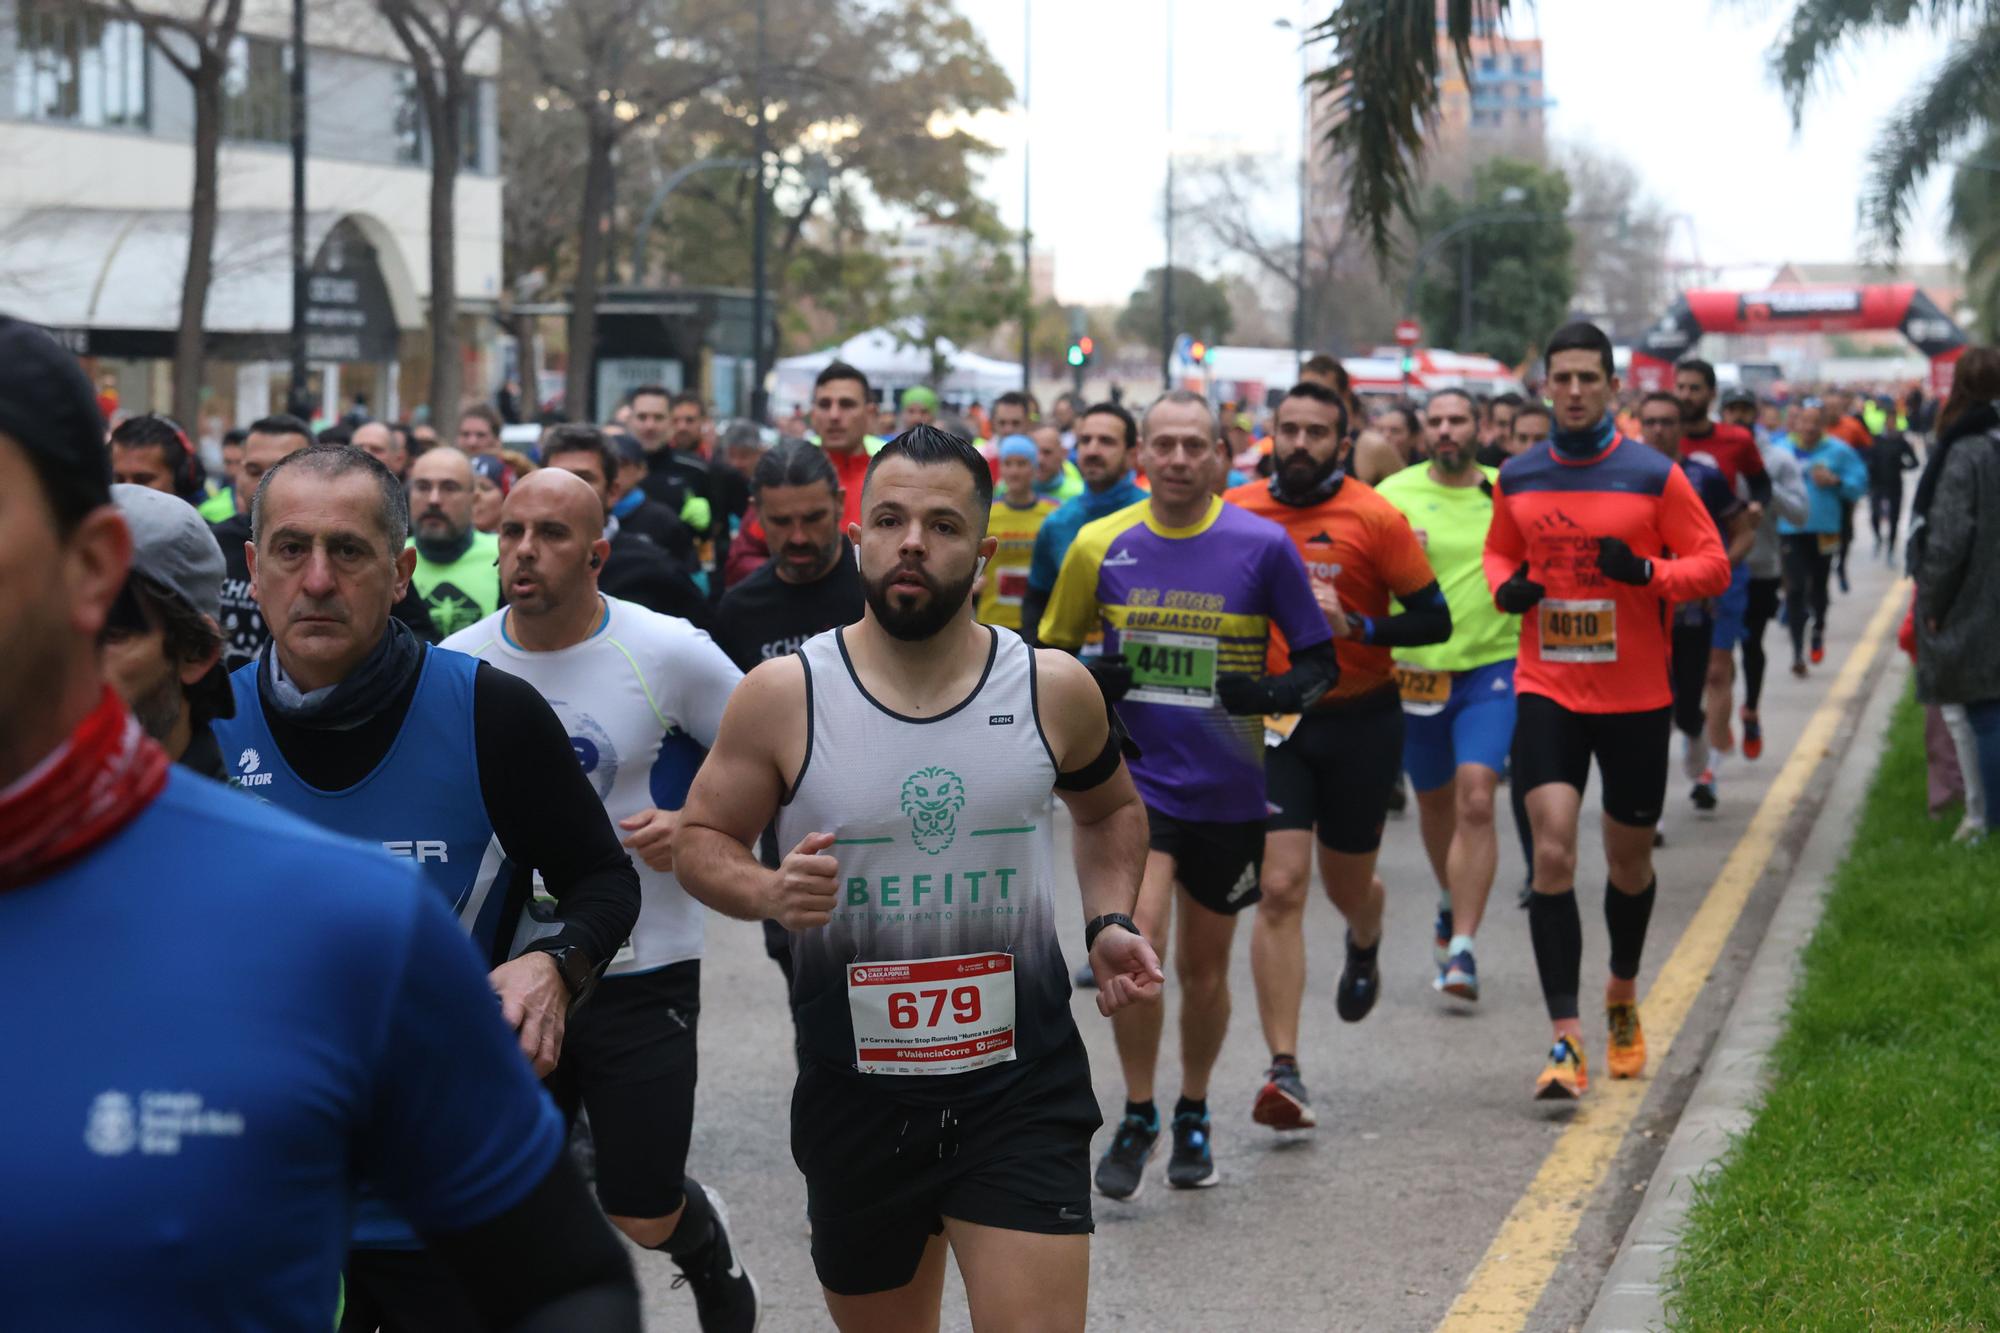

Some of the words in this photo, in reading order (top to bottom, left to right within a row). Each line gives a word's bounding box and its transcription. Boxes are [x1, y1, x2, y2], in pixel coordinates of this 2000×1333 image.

[1126, 611, 1223, 631] BURJASSOT
[1549, 612, 1598, 637] 4010
[1137, 645, 1195, 677] 4411
[232, 773, 273, 787] ATOR
[847, 868, 1017, 906] BEFITT
[887, 985, 982, 1030] 679
[914, 1036, 931, 1044] Stop
[931, 1034, 958, 1042] Running
[896, 1048, 971, 1058] #ValènciaCorre
